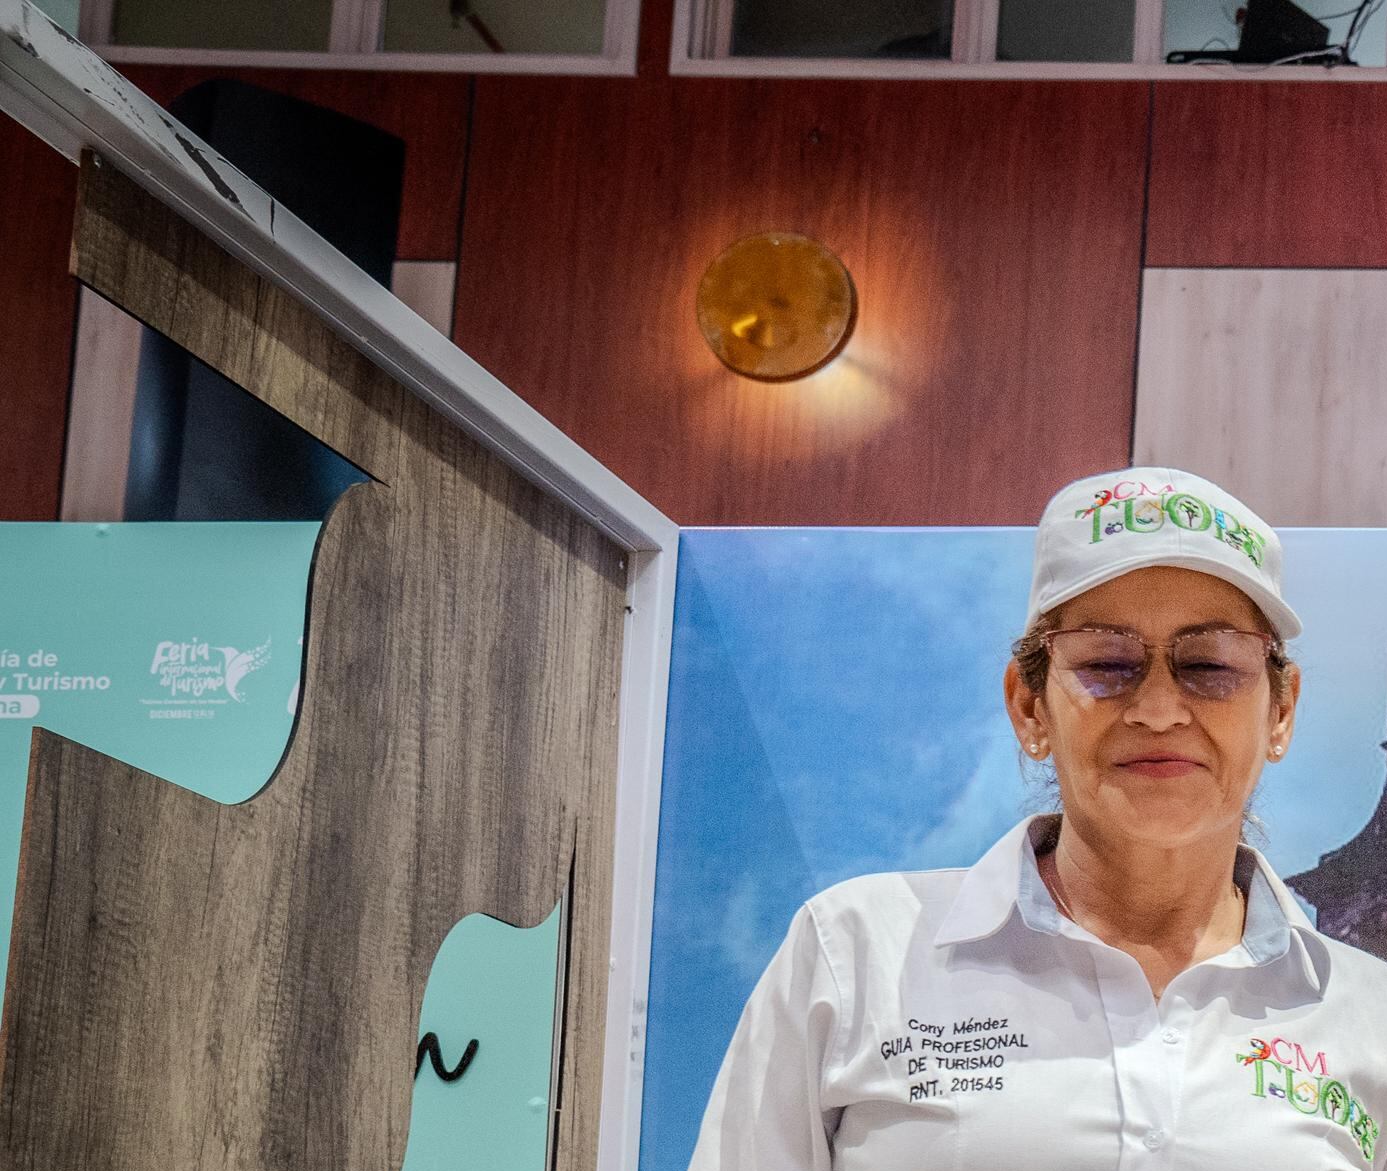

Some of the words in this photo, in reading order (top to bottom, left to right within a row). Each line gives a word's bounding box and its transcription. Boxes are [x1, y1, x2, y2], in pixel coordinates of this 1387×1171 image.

[27, 649, 58, 667] de
[150, 637, 209, 674] Feria
[12, 672, 110, 690] Turismo
[171, 675, 224, 697] Turismo
[908, 1019, 945, 1038] Cony
[953, 1017, 1009, 1036] Méndez
[921, 1034, 1029, 1054] PROFESIONAL
[908, 1056, 927, 1076] DE
[936, 1054, 1004, 1071] TURISMO
[1271, 1037, 1330, 1076] CM
[950, 1076, 1004, 1092] 201545
